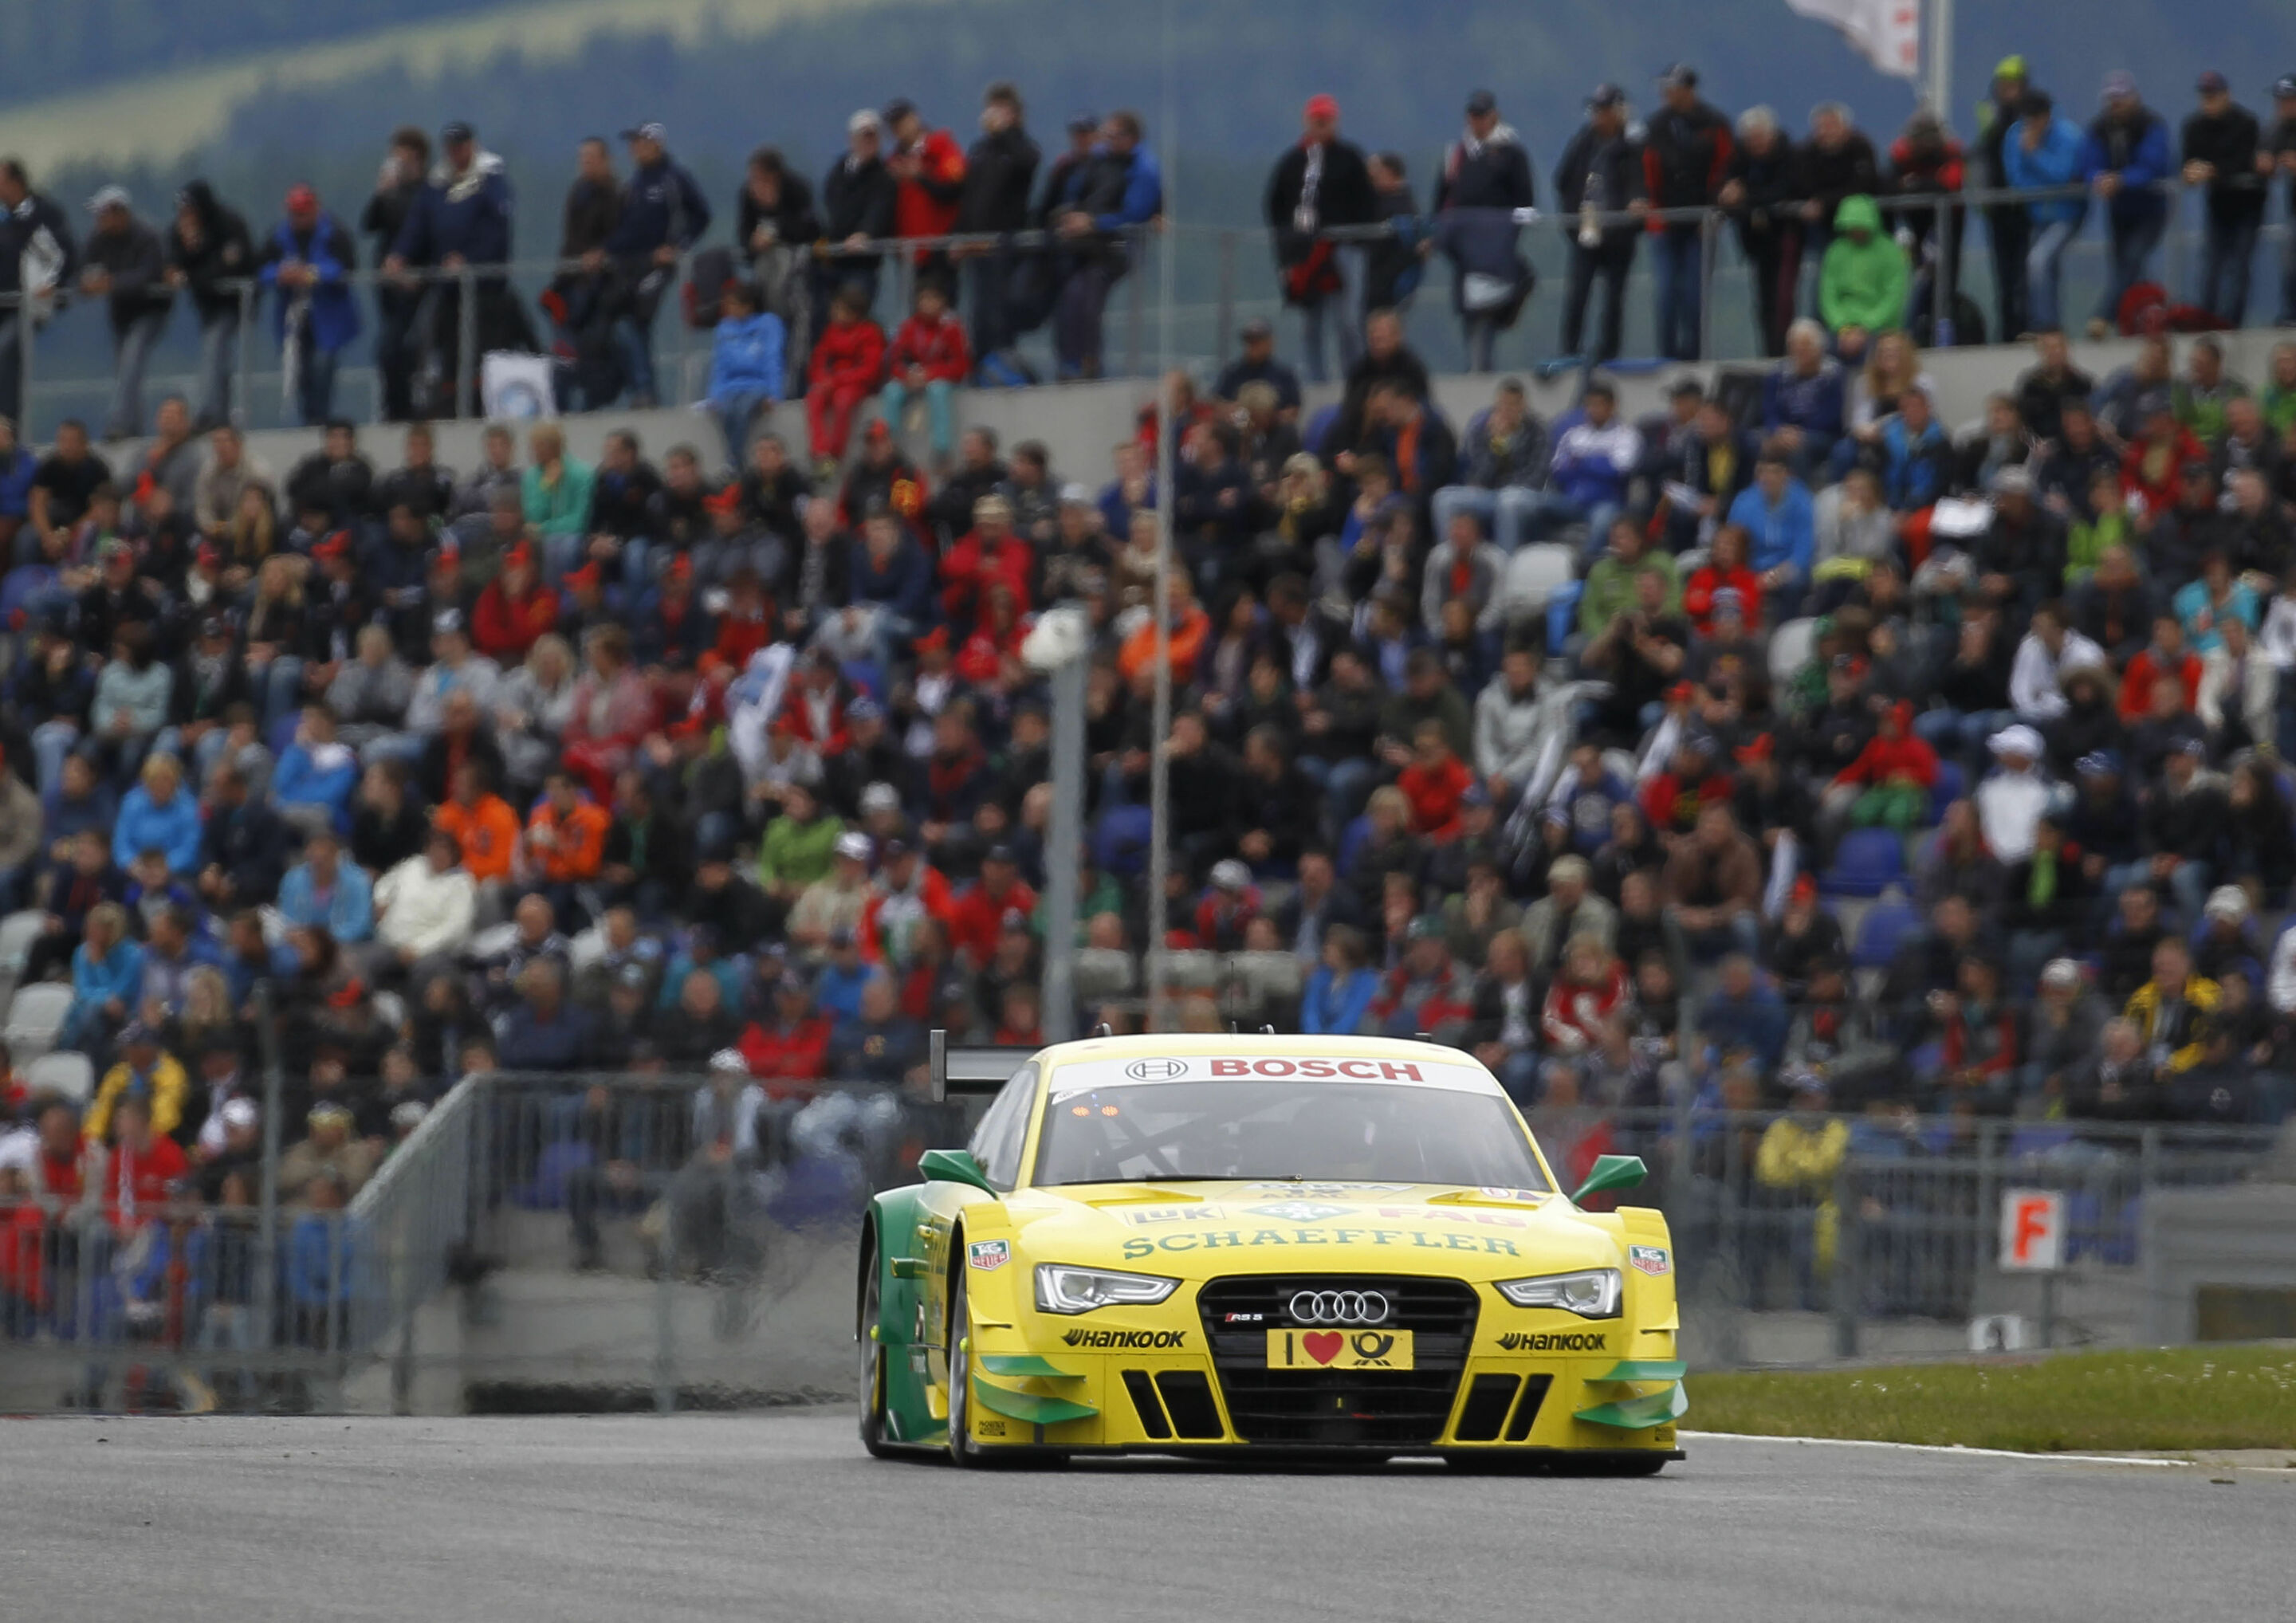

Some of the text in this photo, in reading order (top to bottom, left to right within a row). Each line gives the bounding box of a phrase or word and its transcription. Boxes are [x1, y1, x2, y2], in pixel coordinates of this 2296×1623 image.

[1210, 1059, 1425, 1082] BOSCH
[1378, 1208, 1527, 1228] FAG
[2013, 1197, 2050, 1263] F
[1122, 1228, 1521, 1259] SCHAEFFLER
[1286, 1332, 1293, 1366] I
